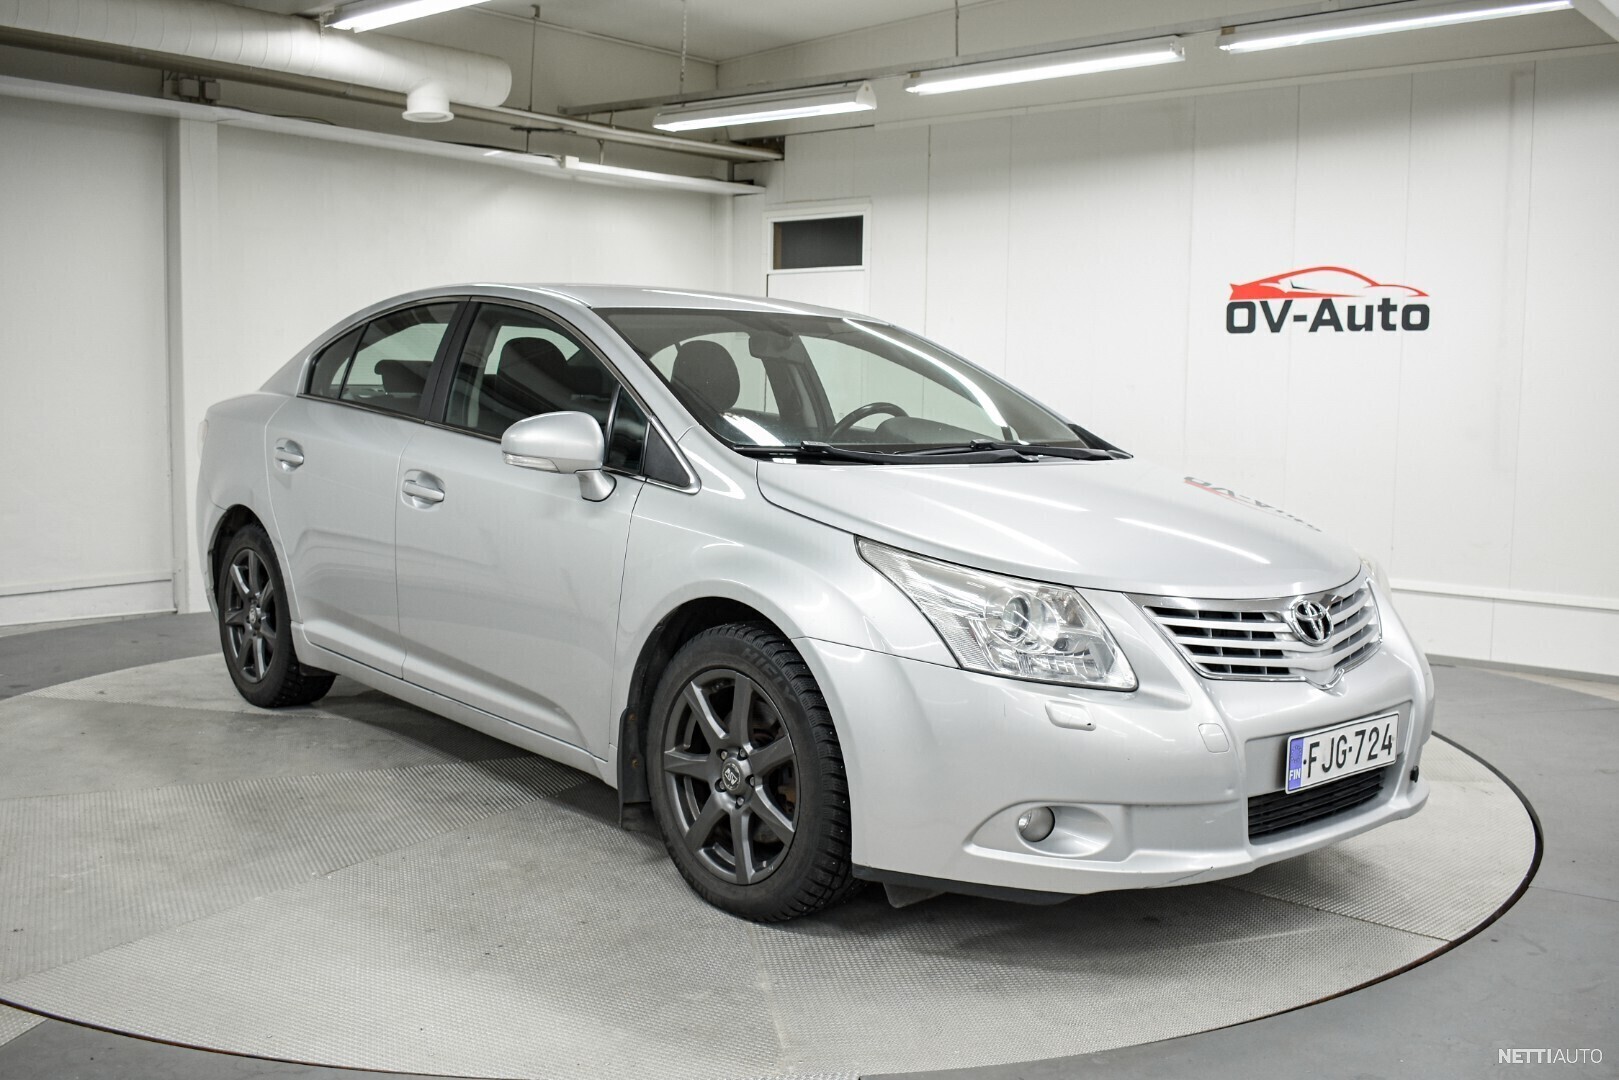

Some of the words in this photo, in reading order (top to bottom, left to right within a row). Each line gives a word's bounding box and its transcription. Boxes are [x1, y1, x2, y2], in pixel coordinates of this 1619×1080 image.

[1226, 298, 1430, 334] OV-Auto
[1307, 723, 1393, 778] FJG-724
[1289, 768, 1301, 781] FIN
